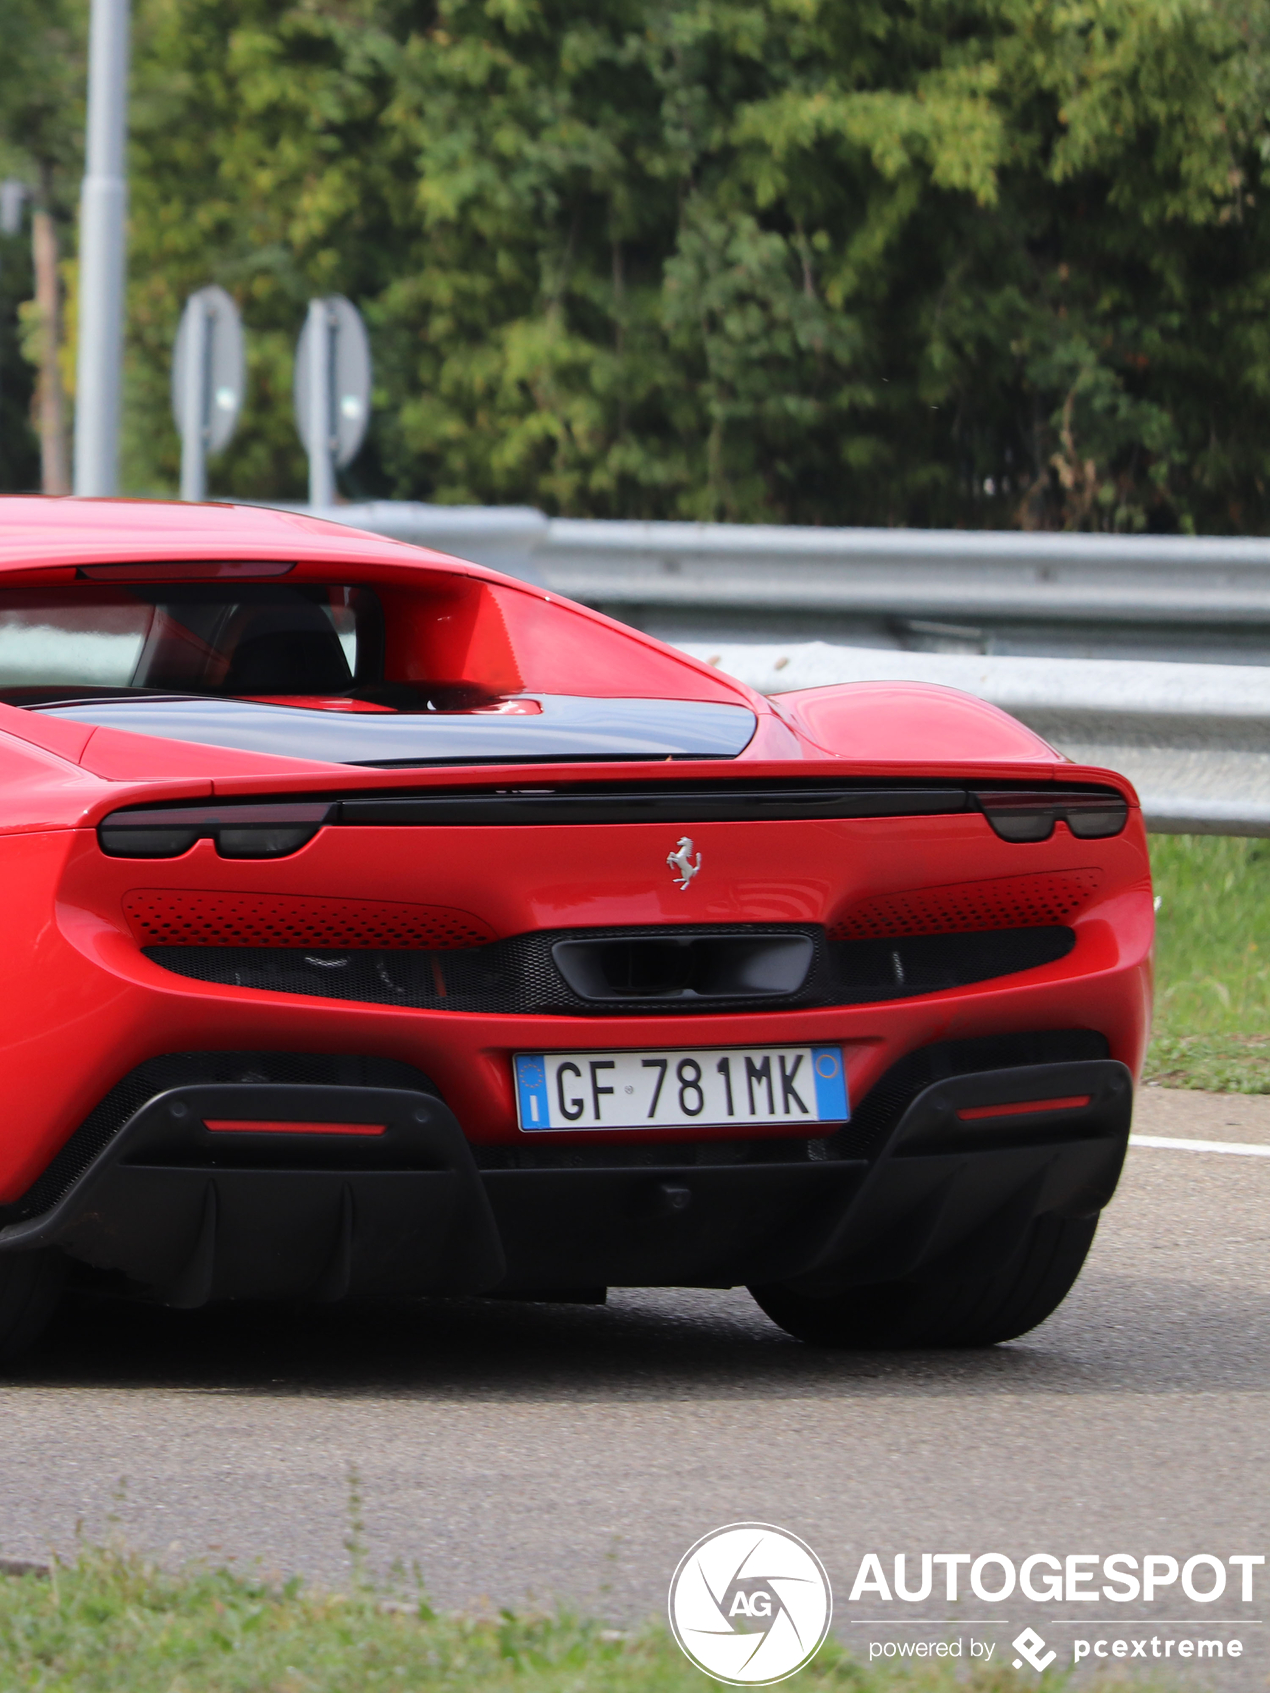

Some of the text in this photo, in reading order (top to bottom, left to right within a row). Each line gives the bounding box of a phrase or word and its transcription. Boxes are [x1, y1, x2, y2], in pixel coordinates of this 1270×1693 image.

[530, 1095, 539, 1122] I
[556, 1054, 810, 1121] GF 781MK
